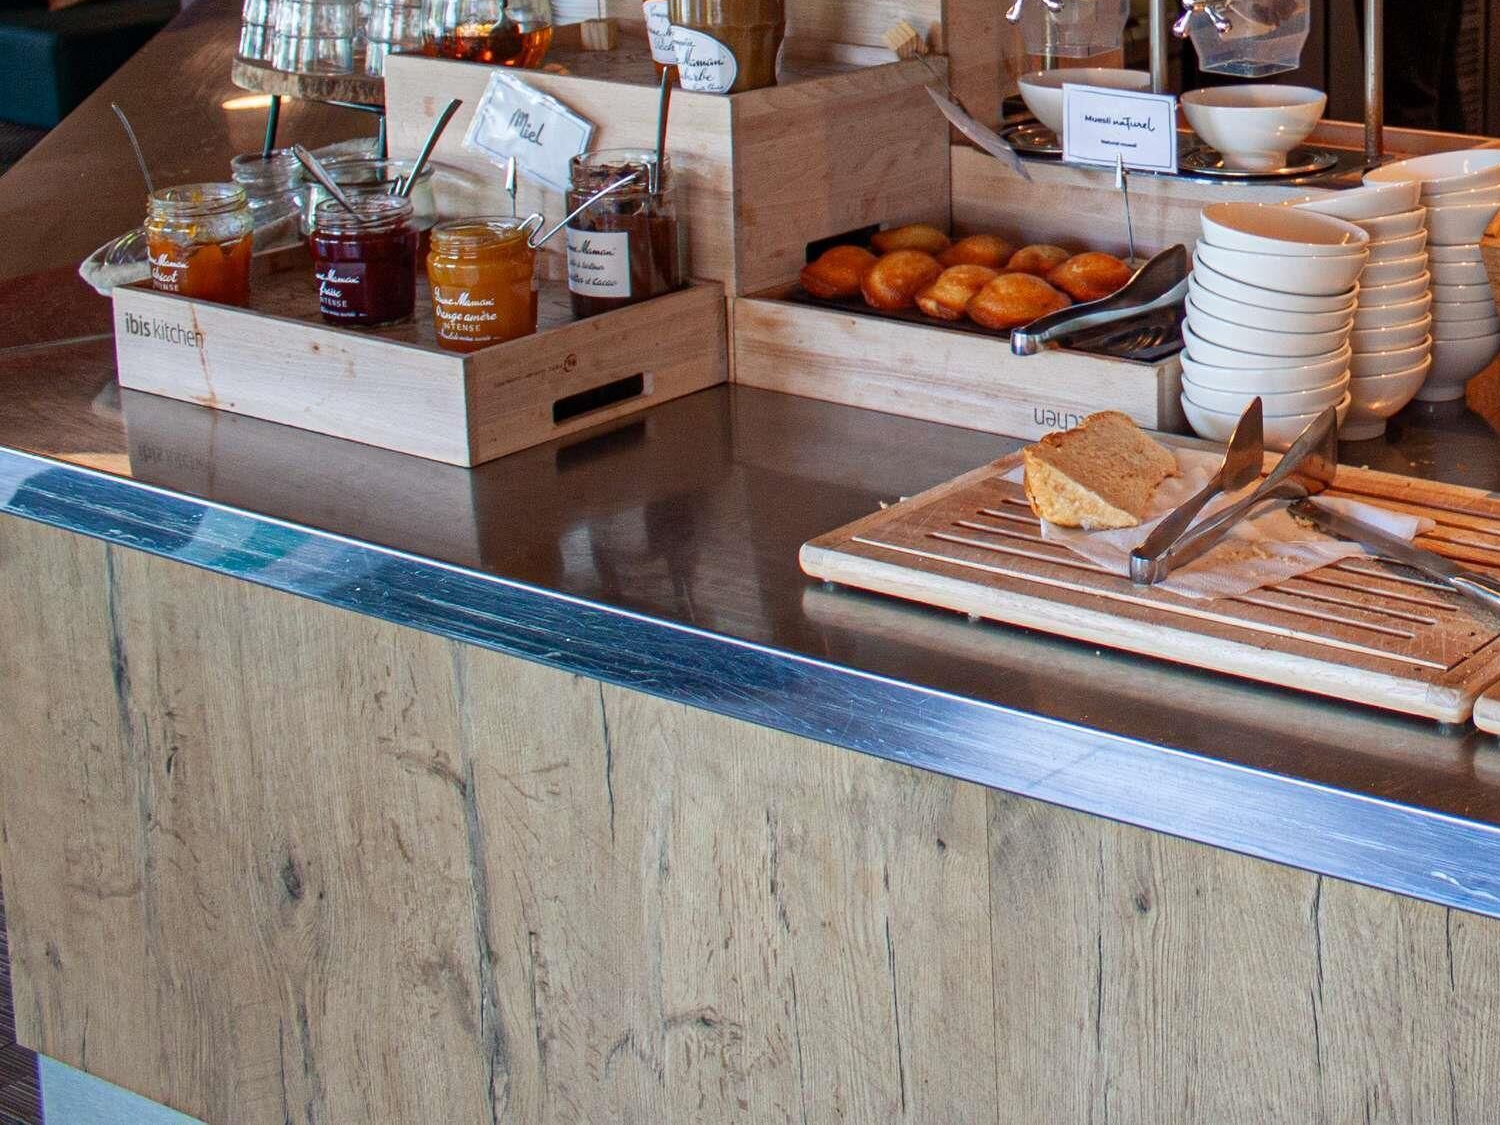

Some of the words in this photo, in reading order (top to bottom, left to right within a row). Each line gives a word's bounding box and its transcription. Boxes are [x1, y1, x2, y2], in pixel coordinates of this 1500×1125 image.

[508, 108, 545, 146] Miel
[1113, 116, 1156, 132] naturel
[125, 312, 151, 337] ibis
[153, 318, 204, 348] kitchen
[1034, 407, 1085, 432] chen
